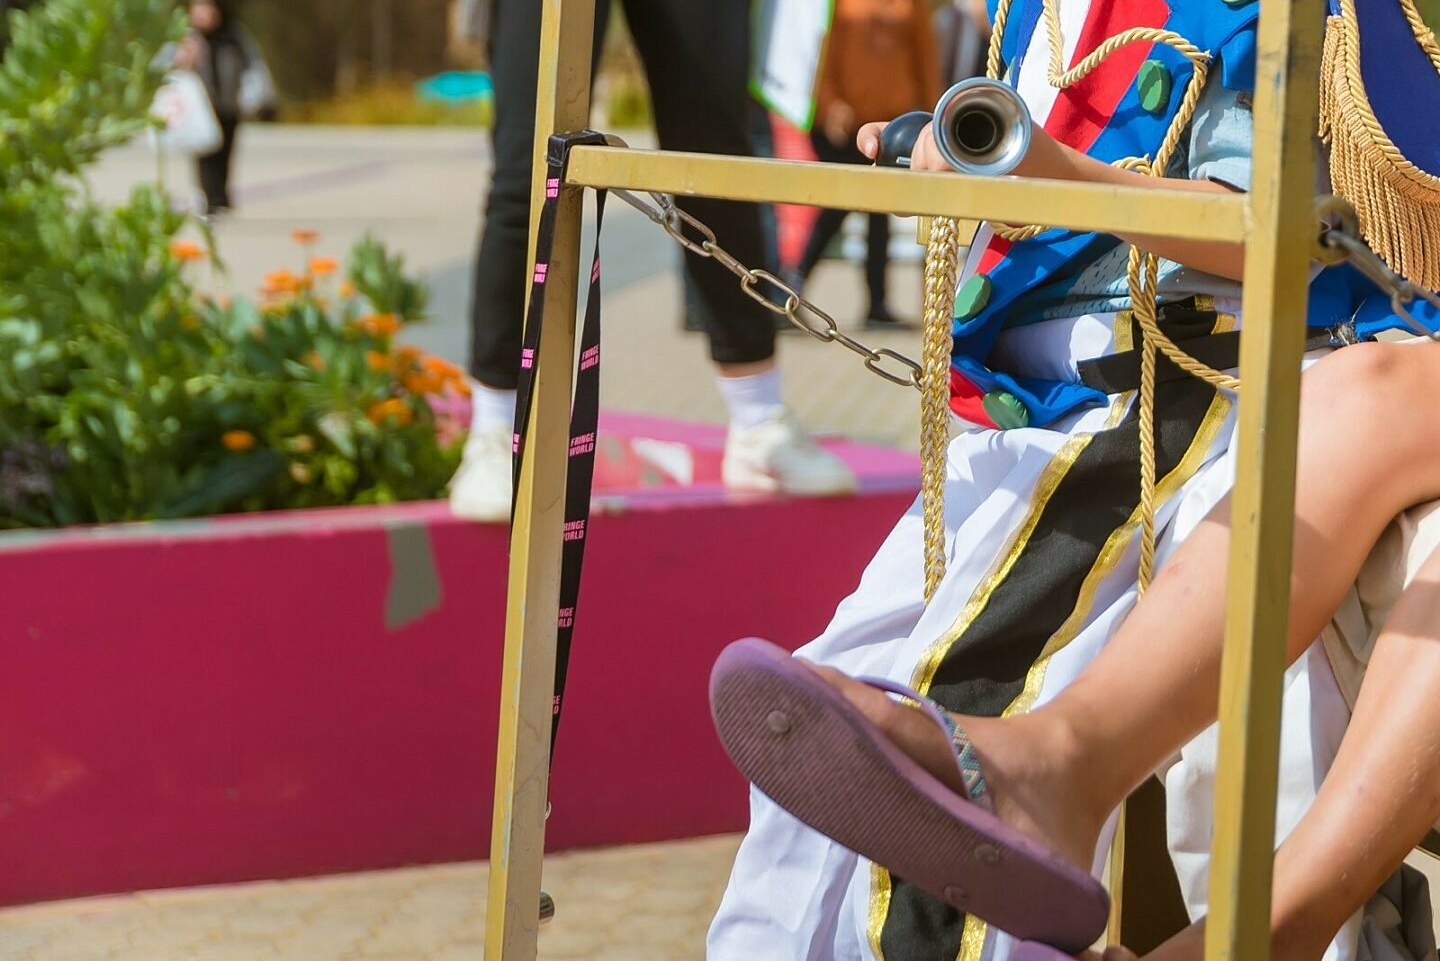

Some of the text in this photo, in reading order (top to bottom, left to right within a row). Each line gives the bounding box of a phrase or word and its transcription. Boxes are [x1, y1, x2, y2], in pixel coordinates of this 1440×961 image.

[570, 432, 595, 448] FRINGE
[569, 442, 594, 457] WORLD
[563, 519, 585, 532] RINGE
[563, 529, 584, 541] ORLD
